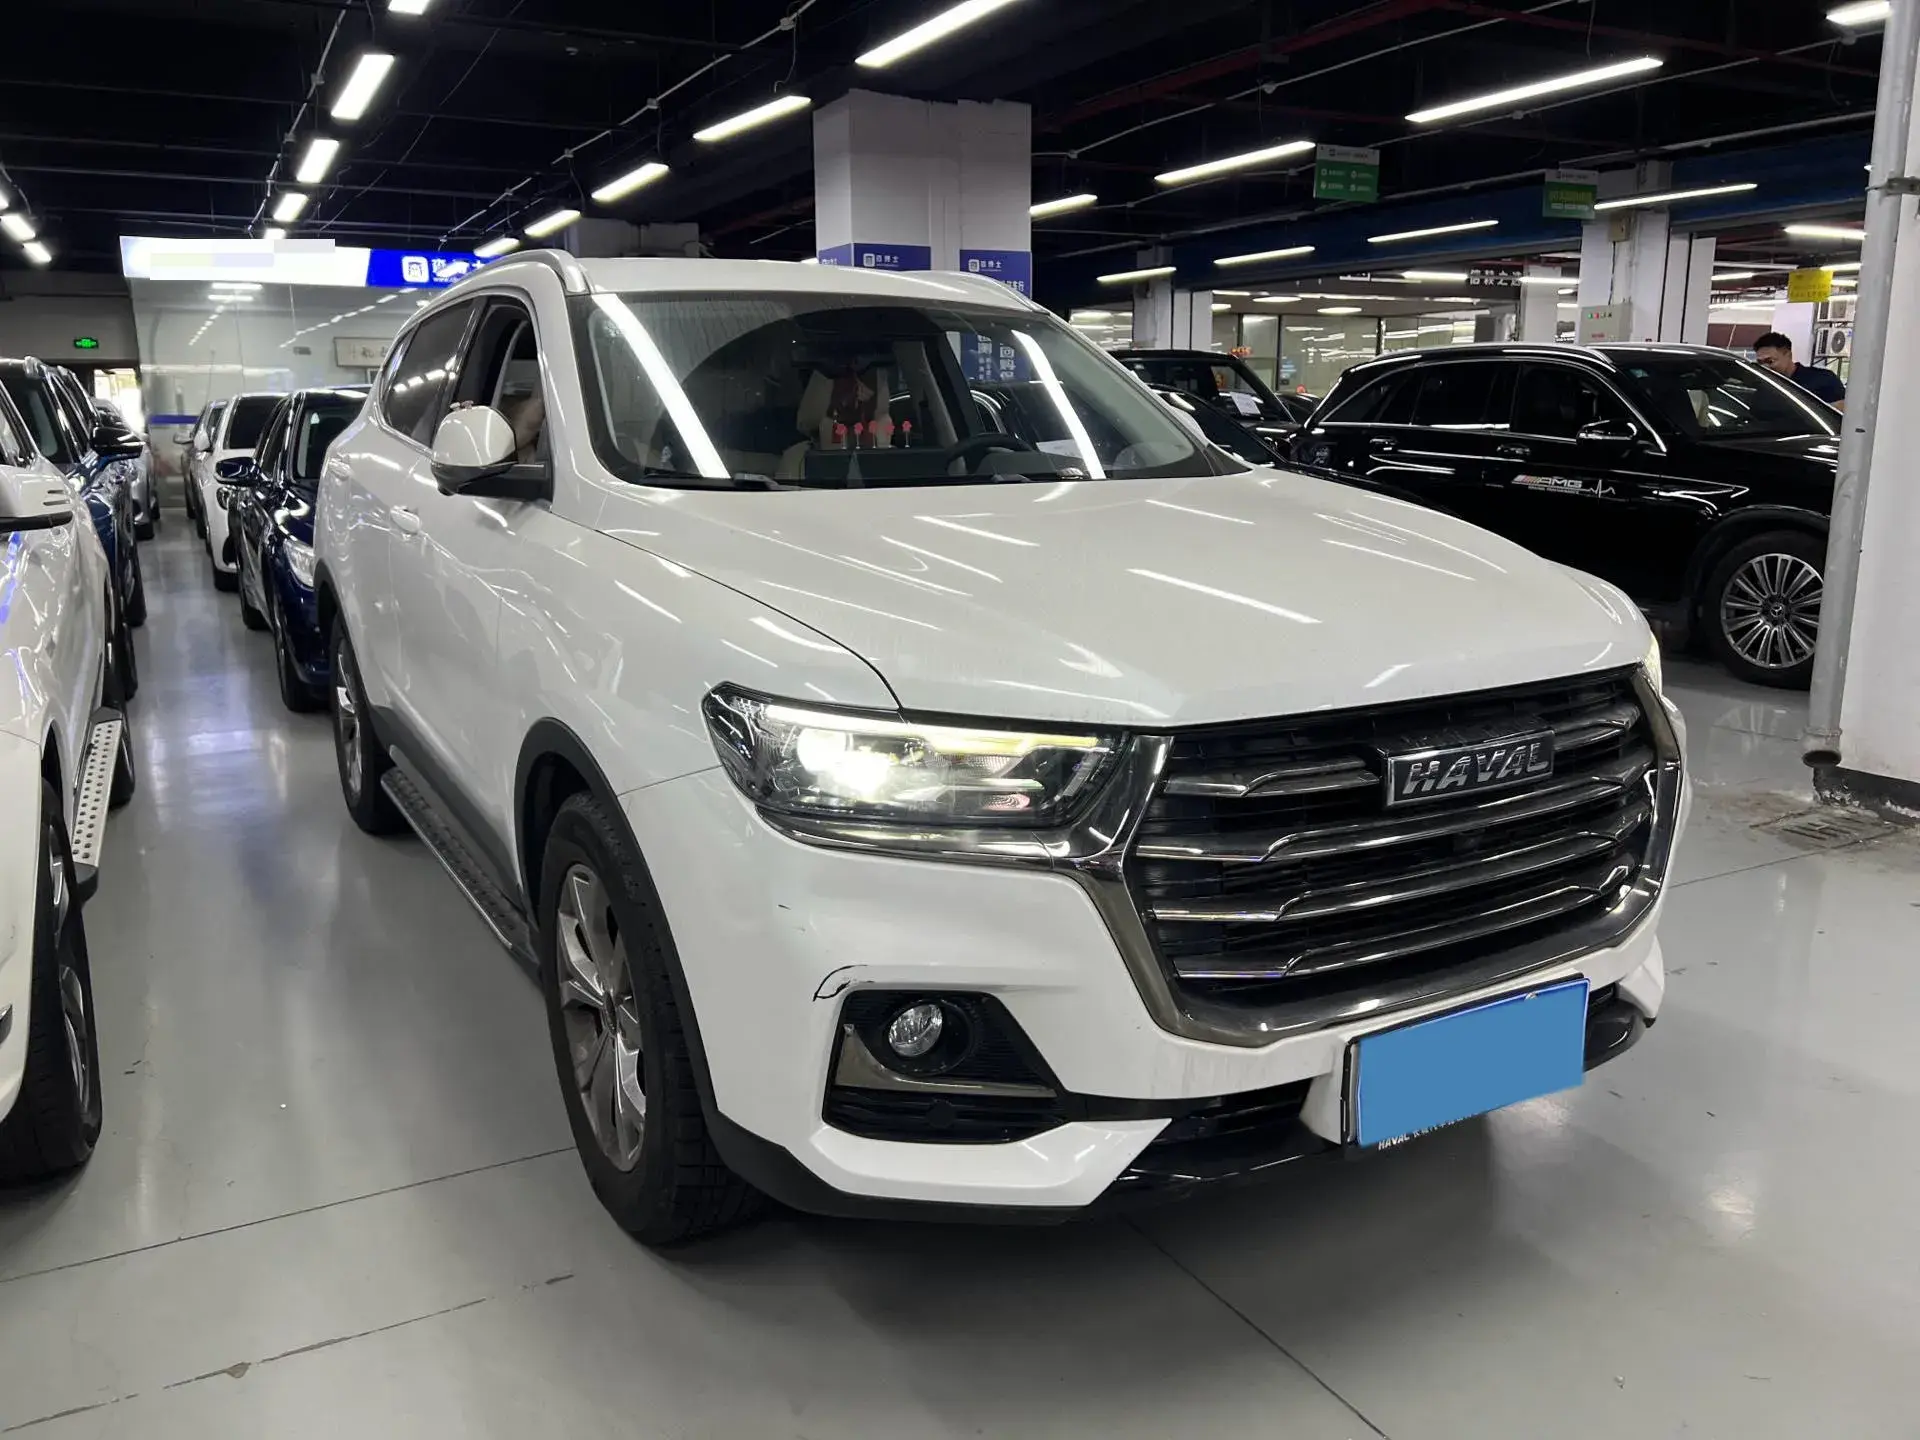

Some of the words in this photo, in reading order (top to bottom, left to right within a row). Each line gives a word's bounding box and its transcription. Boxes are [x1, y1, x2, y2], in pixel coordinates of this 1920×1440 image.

[1539, 476, 1583, 488] AMG
[1402, 742, 1549, 795] HAVAL
[1378, 1133, 1410, 1150] HAVAL
